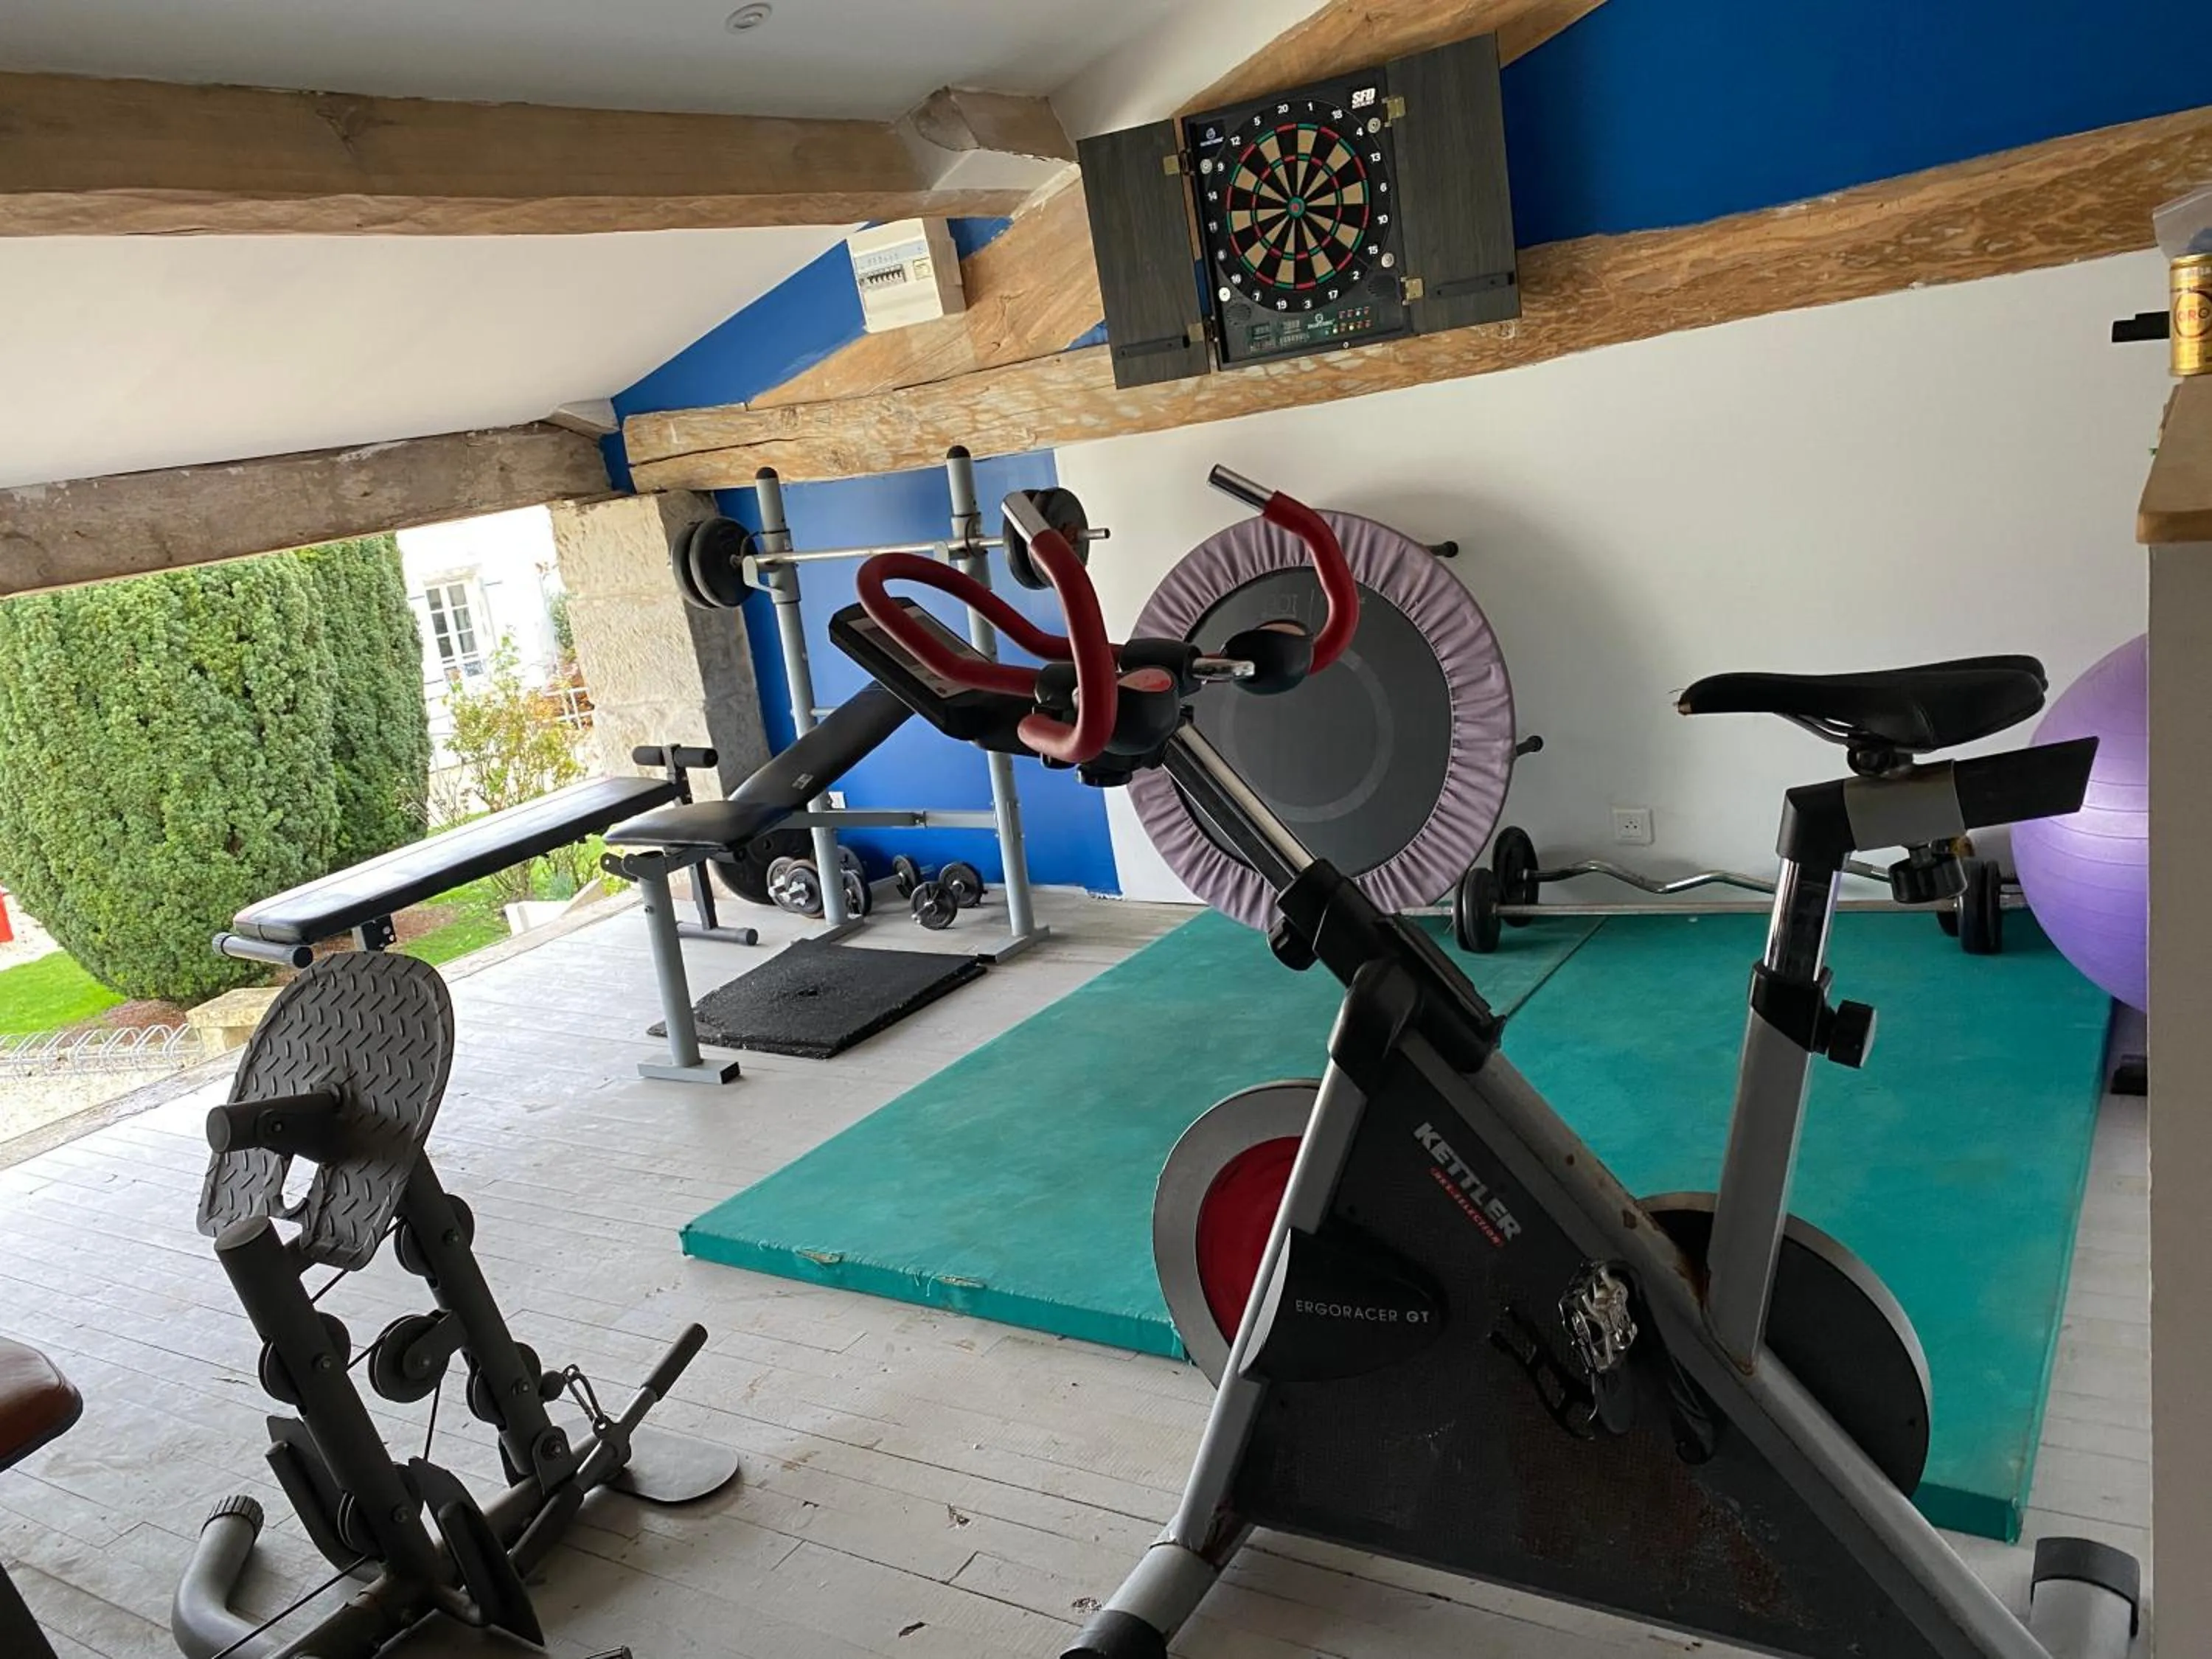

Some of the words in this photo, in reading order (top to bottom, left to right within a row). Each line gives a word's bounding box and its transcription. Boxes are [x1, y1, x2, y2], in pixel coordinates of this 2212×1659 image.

[1277, 103, 1289, 114] 20
[1308, 102, 1312, 111] 1
[1253, 116, 1261, 126] 5
[1356, 127, 1363, 136] 4
[1230, 136, 1241, 146] 12
[1370, 152, 1381, 162] 13
[1217, 162, 1225, 172] 9
[1380, 183, 1388, 192] 6
[1377, 215, 1388, 225] 10
[1368, 245, 1378, 255] 15
[1352, 271, 1360, 280] 2
[1253, 291, 1260, 302] 7
[1328, 290, 1338, 299] 17
[1276, 299, 1287, 310] 19
[1304, 299, 1312, 310] 3
[1413, 1121, 1521, 1242] KETTLER
[1295, 1299, 1398, 1321] ERGORACER
[1406, 1310, 1429, 1322] GT
